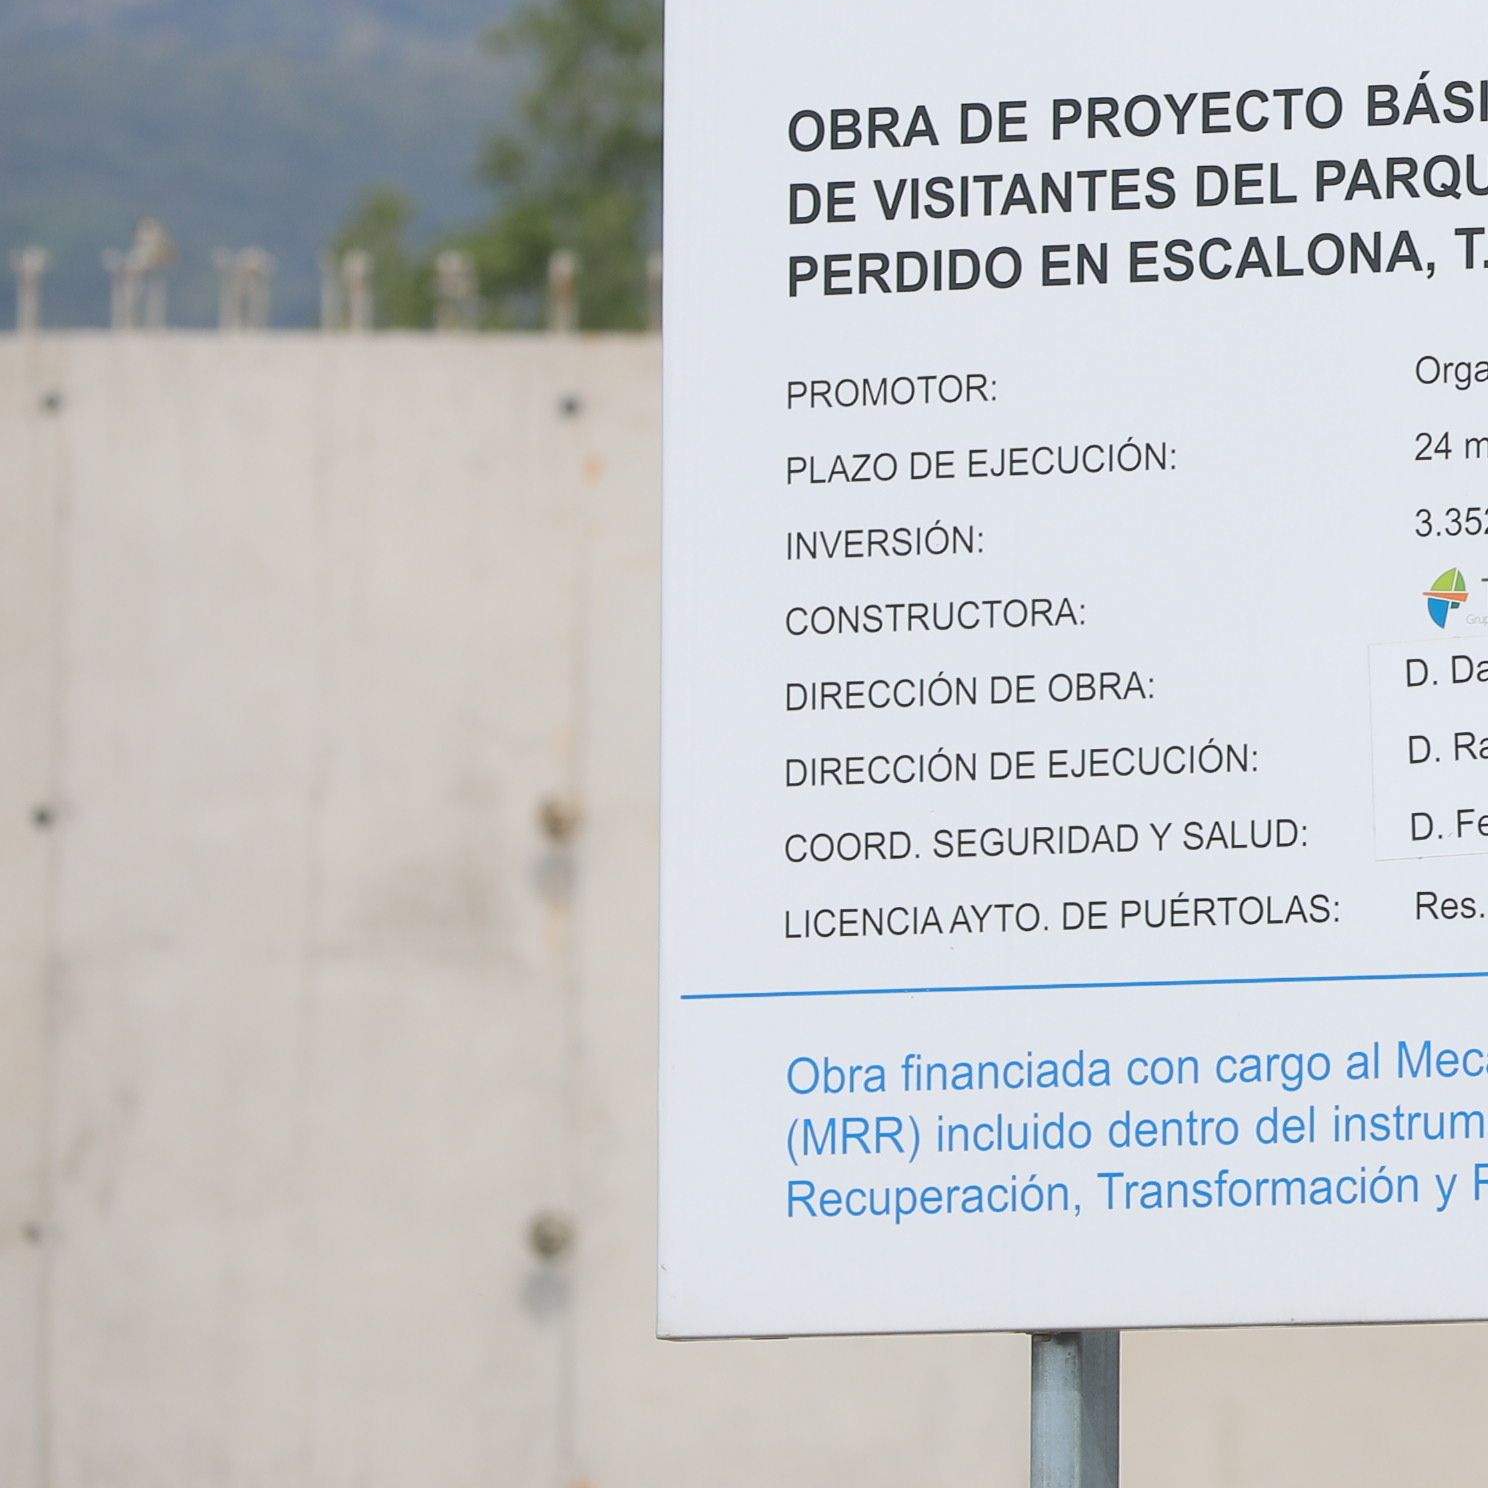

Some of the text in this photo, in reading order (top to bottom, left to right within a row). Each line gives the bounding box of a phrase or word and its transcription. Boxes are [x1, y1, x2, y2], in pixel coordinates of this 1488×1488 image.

[787, 104, 941, 153] OBRA
[959, 99, 1028, 145] DE
[1051, 85, 1344, 141] PROYECTO
[788, 180, 857, 226] DE
[872, 166, 1177, 221] VISITANTES
[1195, 161, 1298, 208] DEL
[788, 245, 1023, 299] PERDIDO
[1041, 242, 1109, 287] EN
[1128, 229, 1436, 284] ESCALONA,
[787, 373, 997, 410] PROMOTOR:
[786, 436, 1177, 486] PLAZO DE EJECUCIÓN:
[1414, 430, 1453, 462] 24
[787, 519, 984, 561] INVERSIÓN:
[785, 597, 1086, 636] CONSTRUCTORA:
[785, 670, 1154, 712] DIRECCIÓN DE OBRA:
[1405, 658, 1438, 688] D.
[785, 737, 1258, 788] DIRECCIÓN DE EJECUCIÓN:
[1408, 734, 1441, 765] D.
[784, 818, 1307, 863] COORD. SEGURIDAD Y SALUD:
[1410, 811, 1443, 842] D.
[784, 891, 1340, 939] LICENCIA AYTO. DE PUÉRTOLAS:
[1415, 890, 1485, 921] Res.
[786, 1056, 887, 1095] Obra
[900, 1049, 1111, 1092] financiada
[1126, 1055, 1199, 1087] con
[1215, 1052, 1331, 1093] cargo
[1346, 1041, 1380, 1081] al
[787, 1114, 920, 1167] (MRR)
[937, 1111, 1092, 1153] incluido
[1108, 1109, 1239, 1149] dentro
[1255, 1105, 1315, 1145] del
[787, 1173, 1081, 1225] Recuperación,
[1096, 1165, 1419, 1210] Transformación
[1434, 1173, 1458, 1213] y
